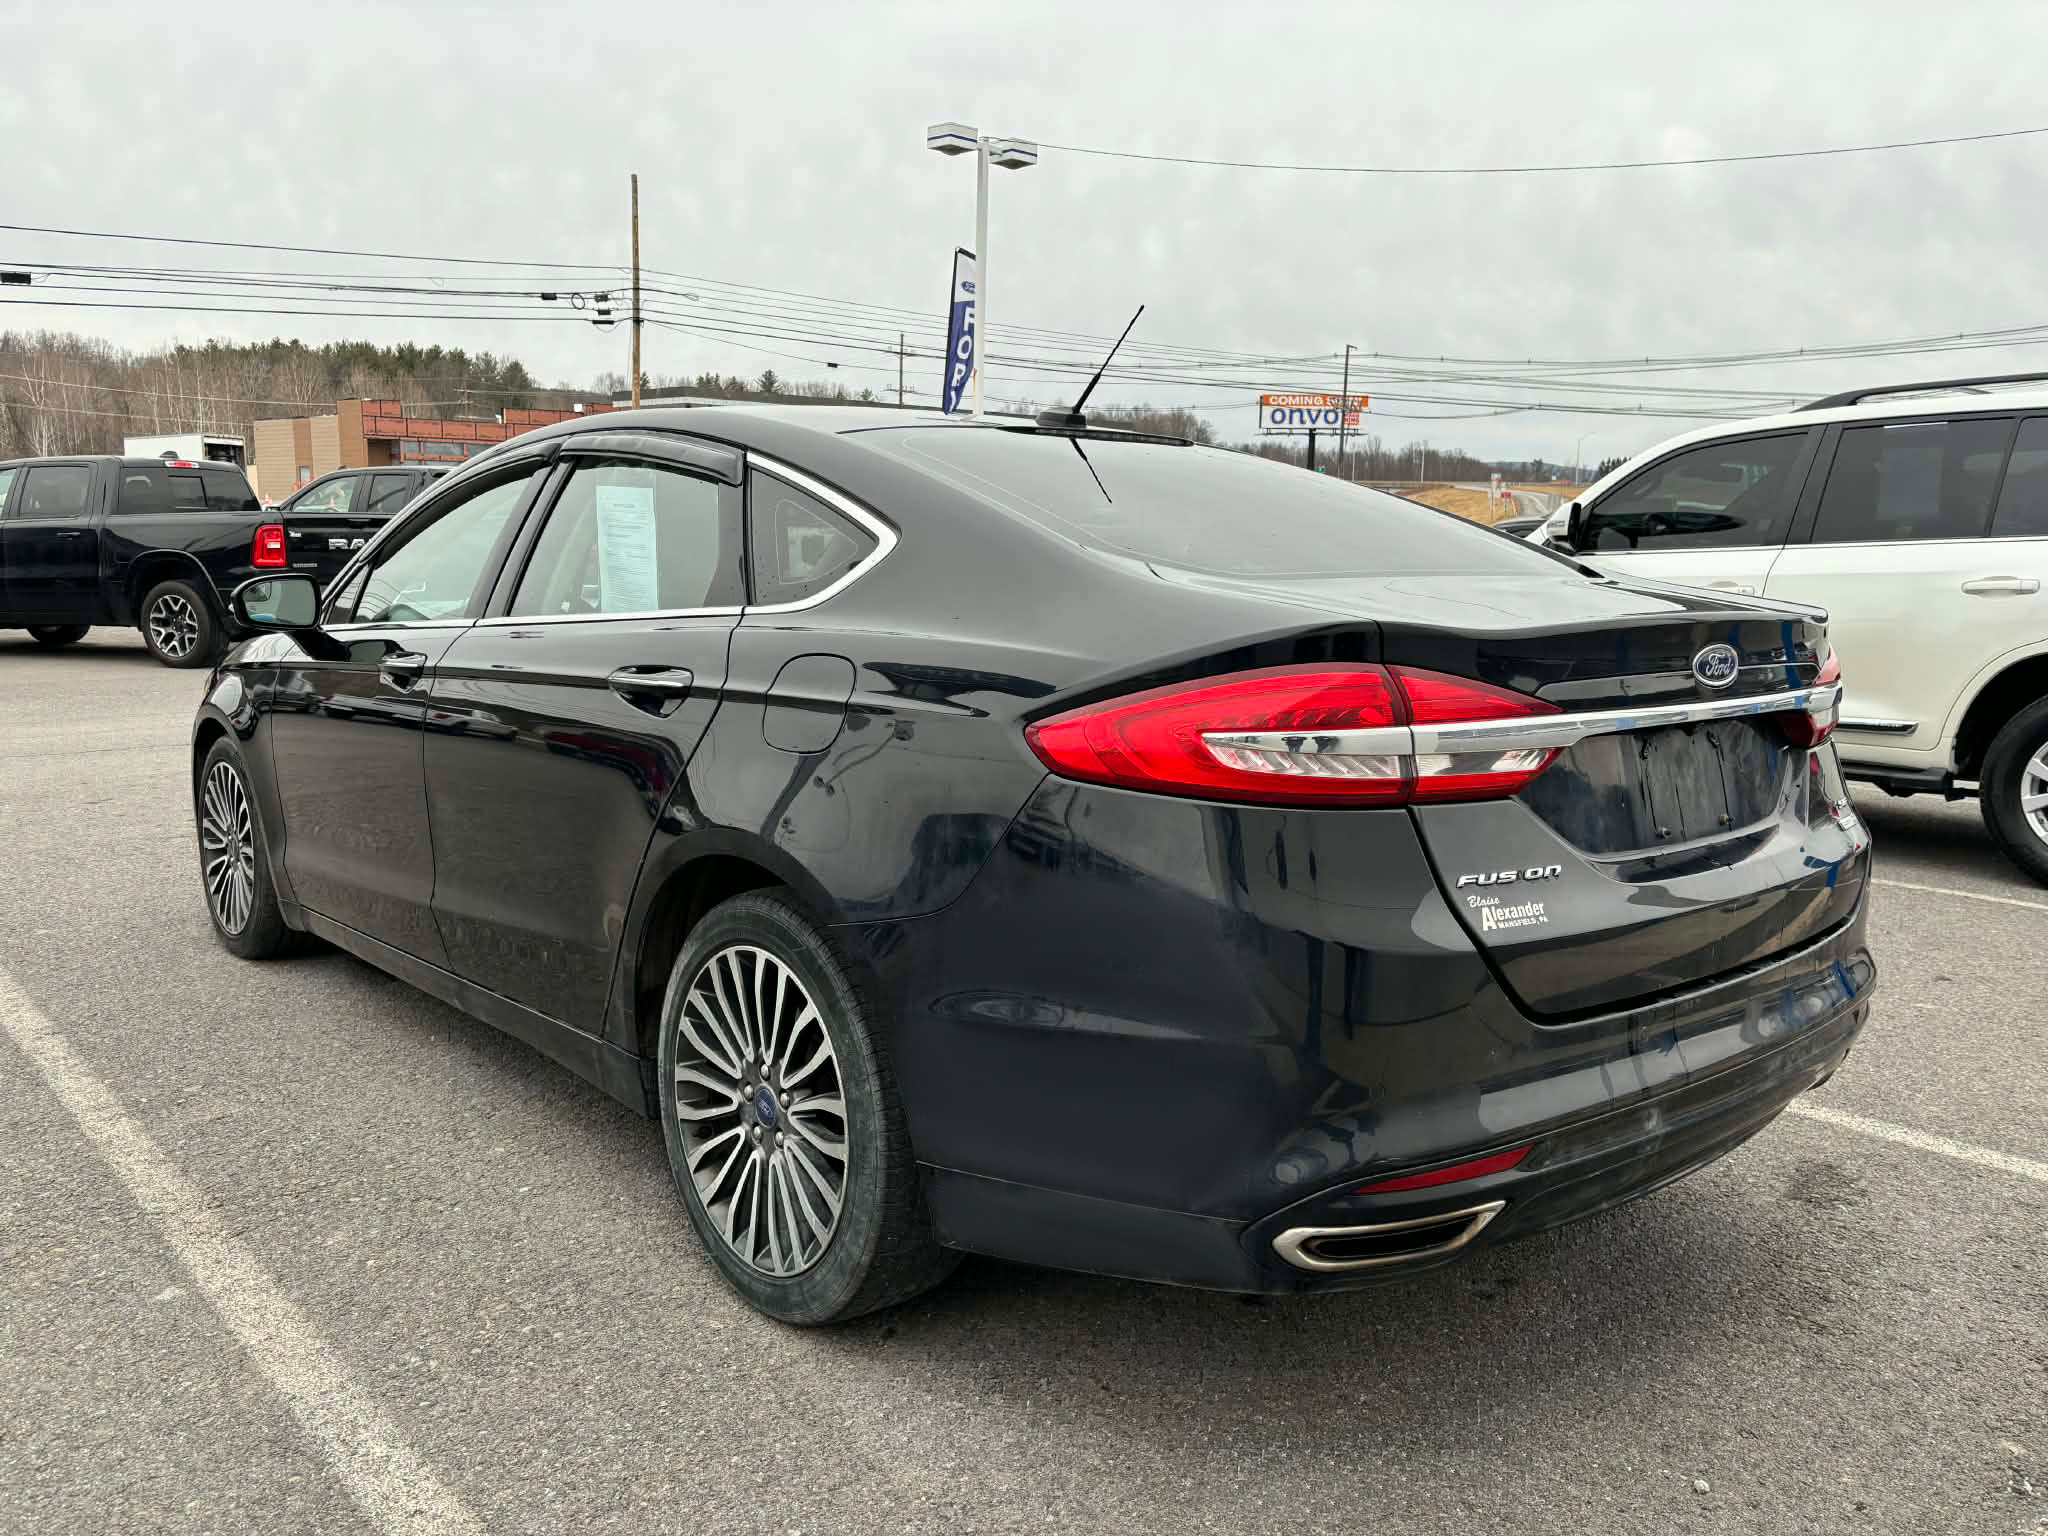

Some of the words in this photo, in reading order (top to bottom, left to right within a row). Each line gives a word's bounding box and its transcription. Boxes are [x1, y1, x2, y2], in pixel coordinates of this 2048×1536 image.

[1269, 396, 1323, 406] COMING
[1270, 407, 1339, 425] onvo
[328, 538, 366, 550] RA
[1706, 653, 1732, 676] Ford
[1456, 864, 1562, 888] FUSION
[1467, 895, 1500, 908] Blaise
[1481, 901, 1545, 931] Alexander
